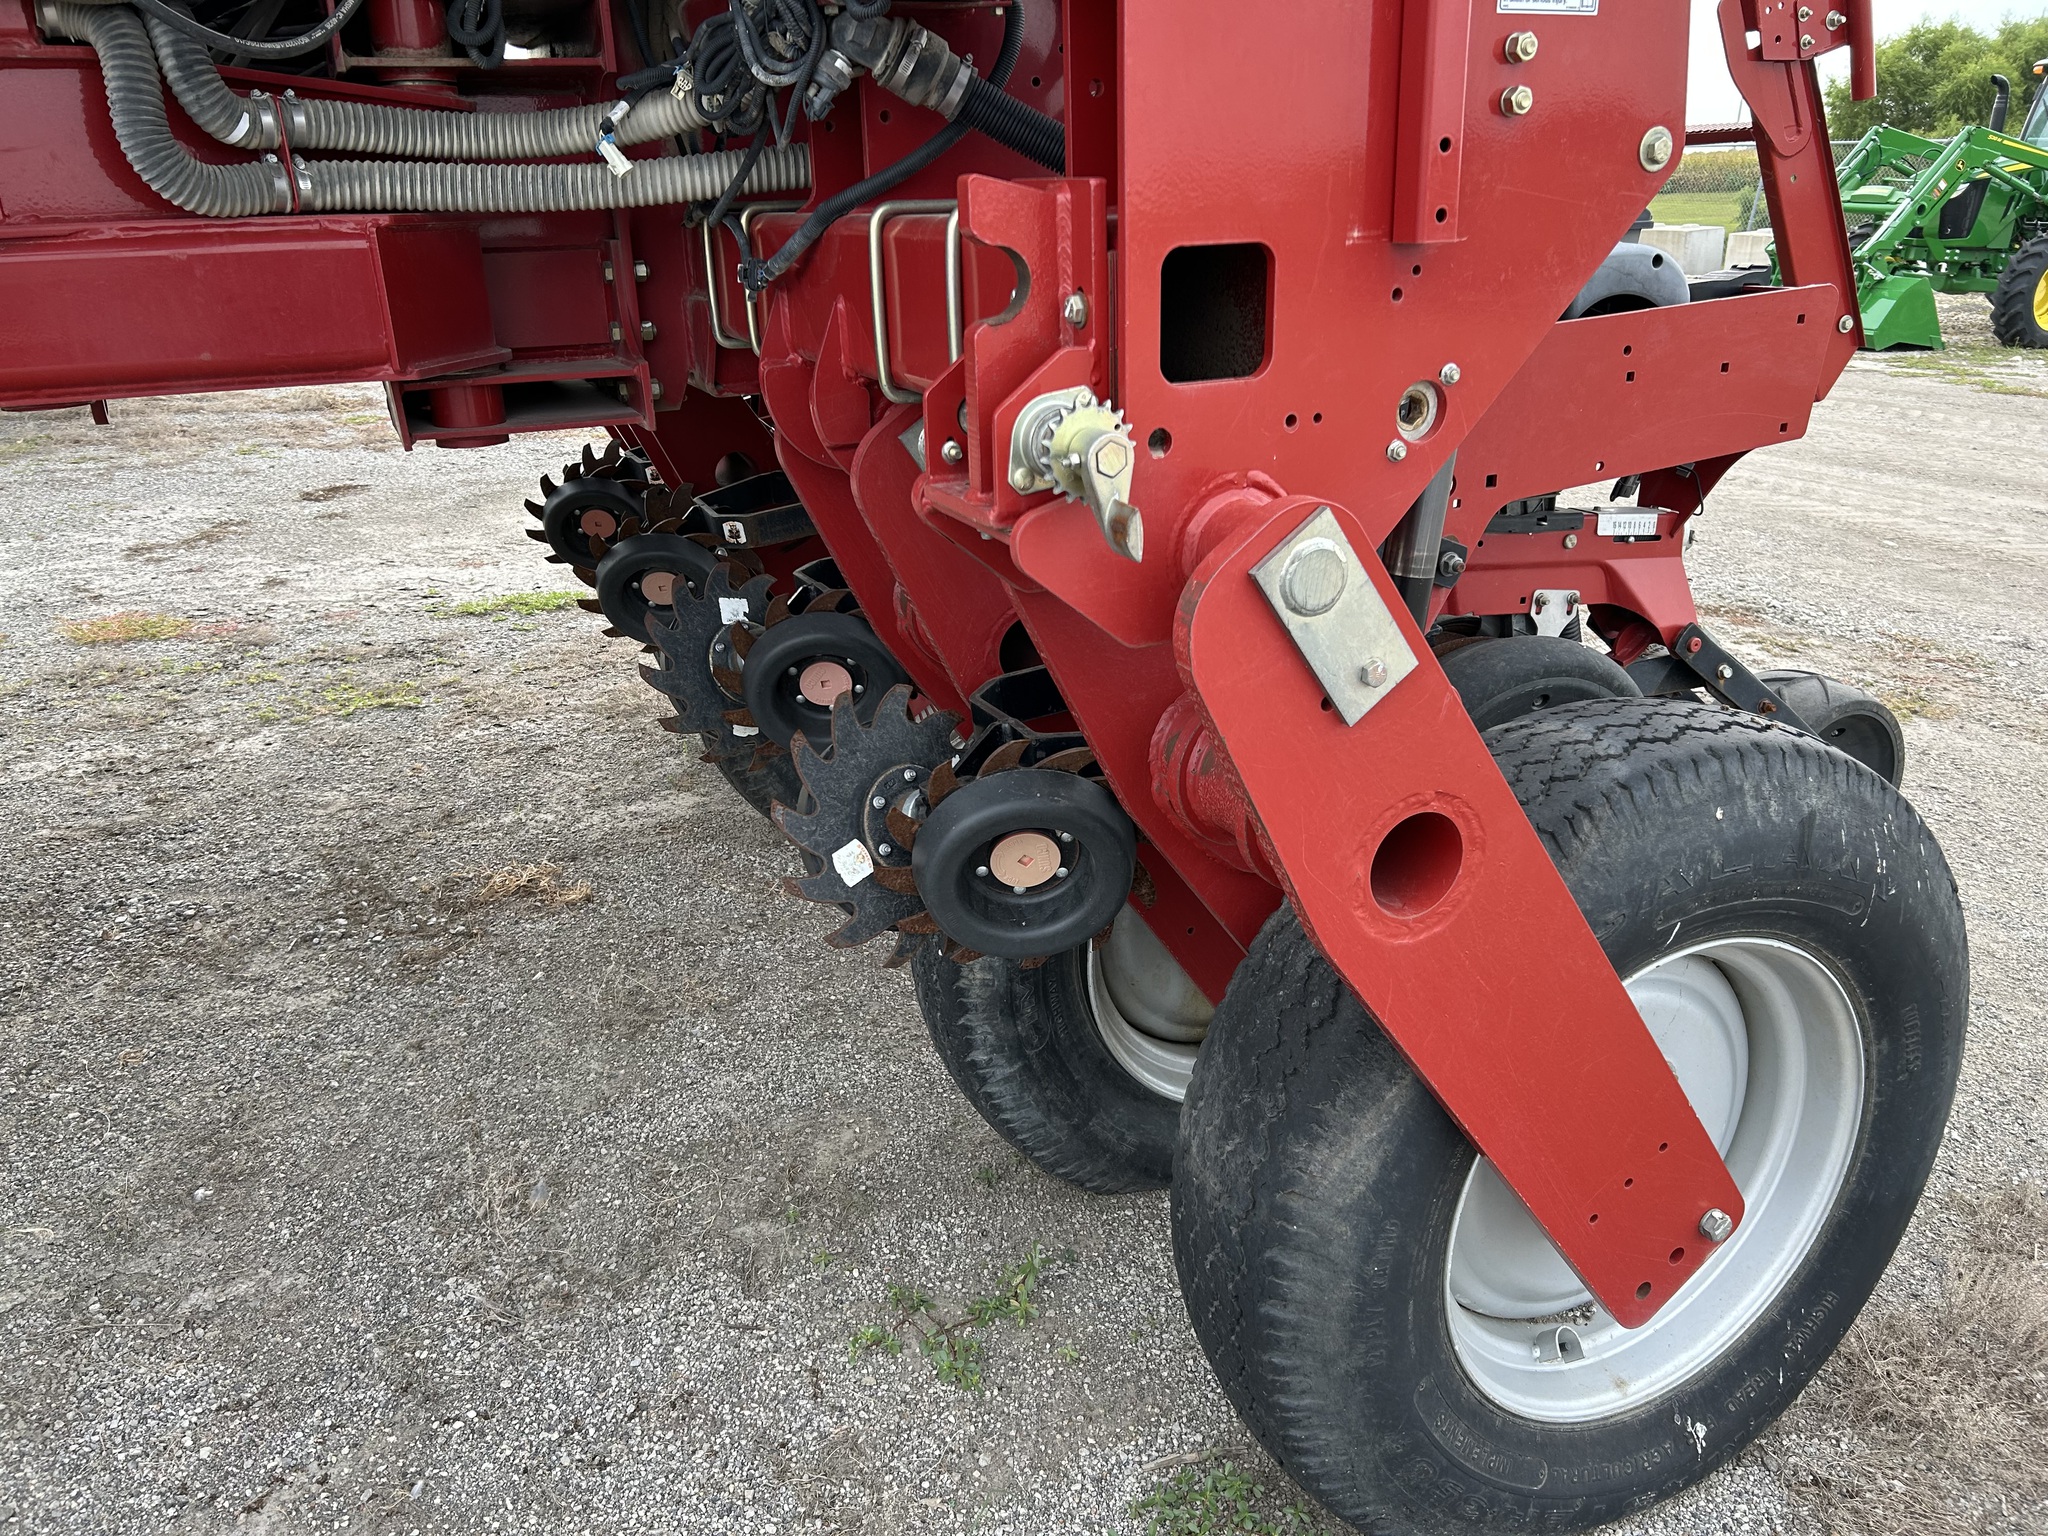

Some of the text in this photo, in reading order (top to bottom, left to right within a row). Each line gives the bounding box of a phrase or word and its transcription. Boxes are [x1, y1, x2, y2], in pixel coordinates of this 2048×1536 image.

[1779, 1289, 1840, 1364] HIGHWAY
[1722, 1366, 1775, 1416] TREAD
[1432, 1412, 1513, 1476] IMPLEMENTS
[1550, 1438, 1676, 1484] AGRICULTURAL
